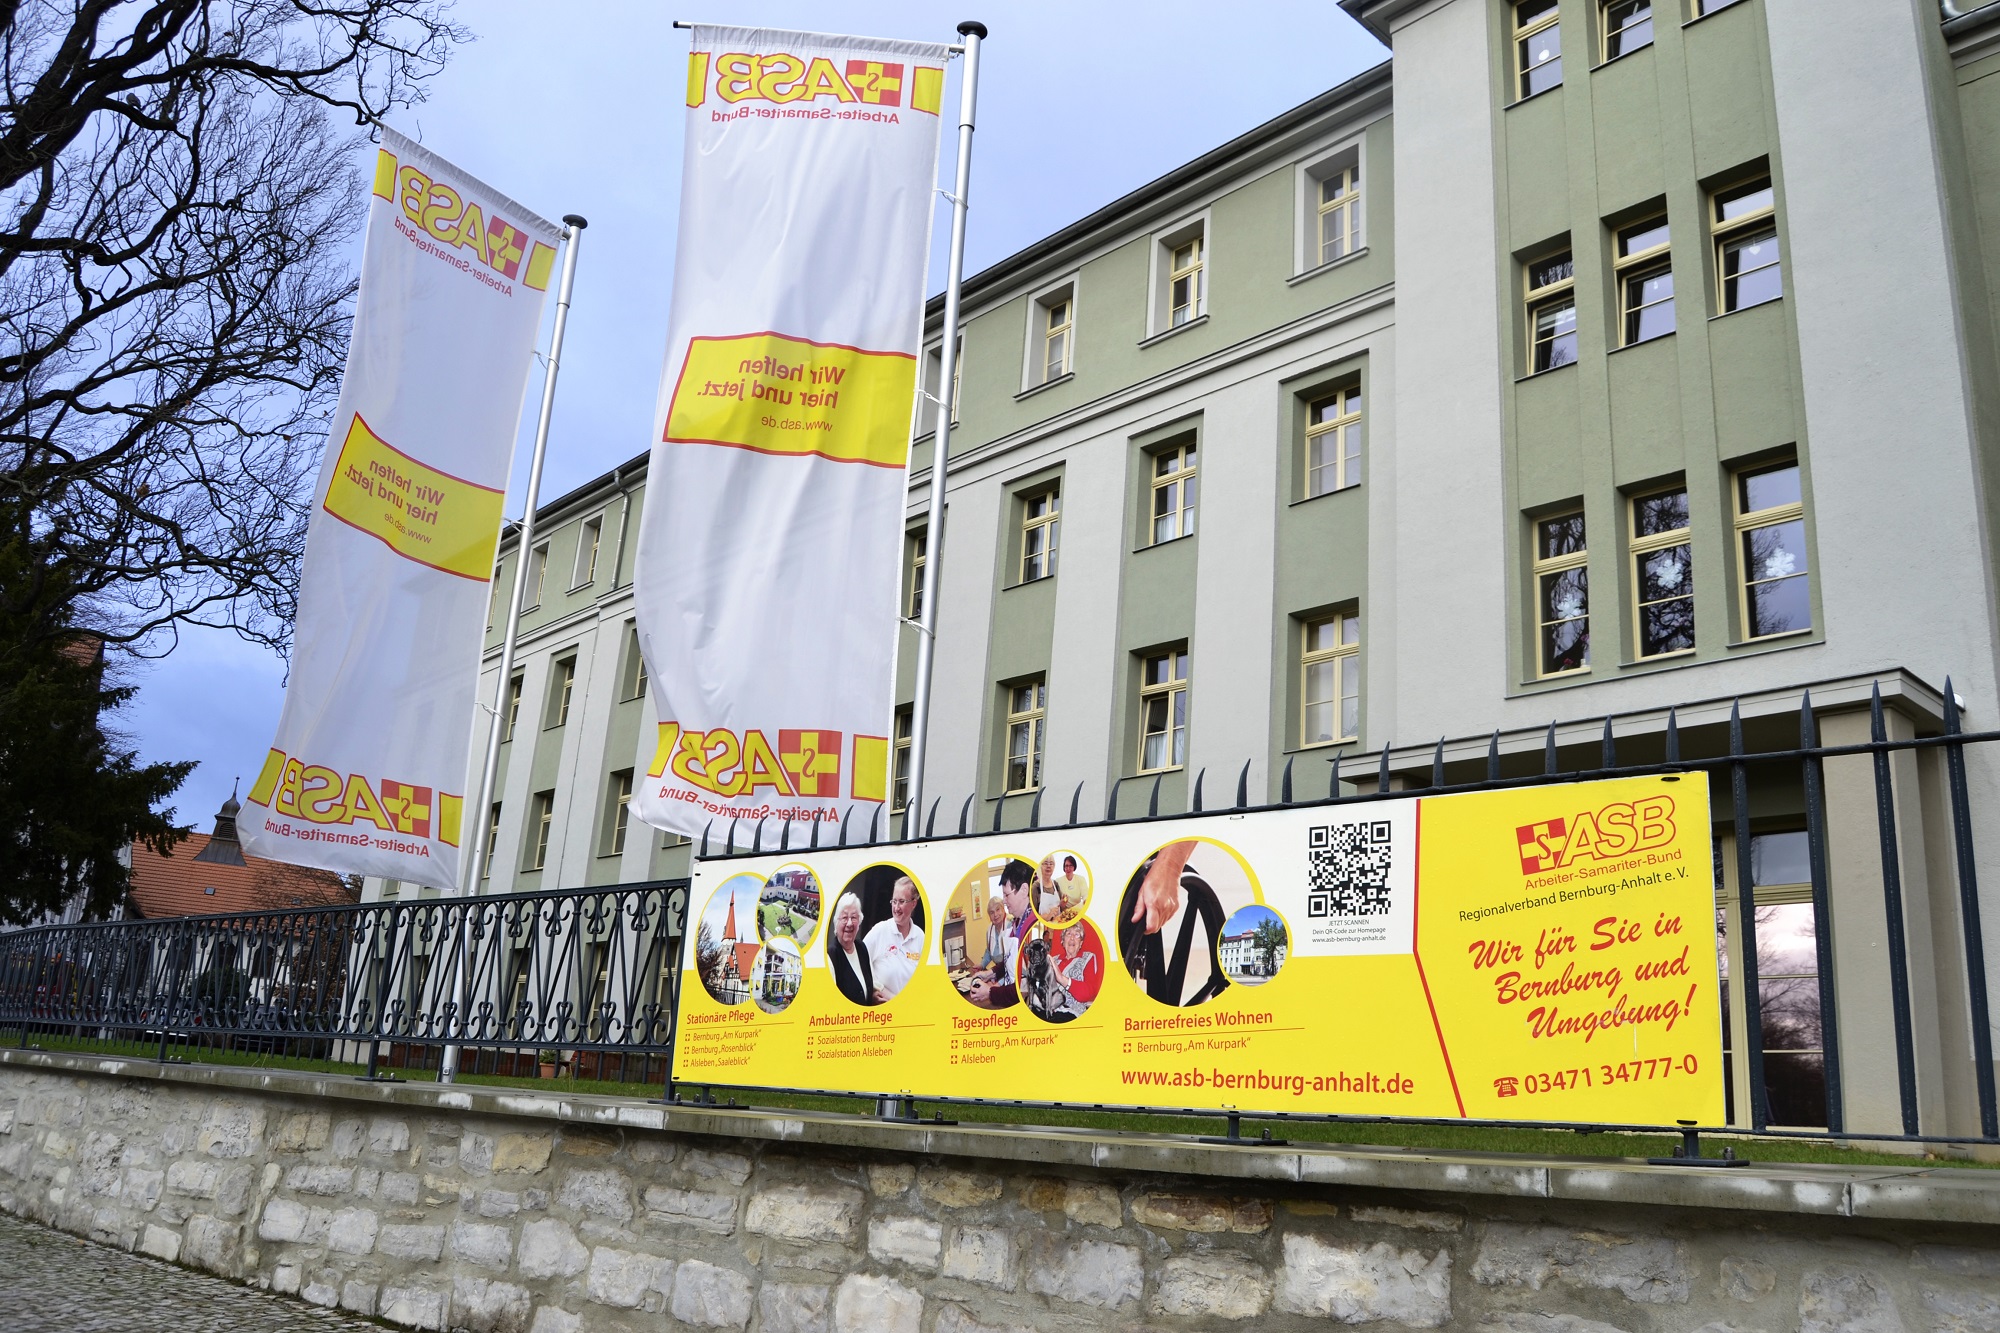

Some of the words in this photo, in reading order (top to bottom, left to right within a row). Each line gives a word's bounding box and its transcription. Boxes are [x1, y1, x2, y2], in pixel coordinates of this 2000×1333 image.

[1556, 795, 1677, 868] ASB
[1525, 848, 1683, 890] Arbeiter-Samariter-Bund
[1459, 892, 1556, 922] Regionalverband
[1559, 870, 1662, 903] Bernburg-Anhalt
[1468, 940, 1524, 970] Wir
[1535, 926, 1577, 970] für
[1590, 916, 1642, 951] Sie
[1654, 912, 1683, 938] in
[1494, 962, 1623, 1005] Bernburg
[1635, 945, 1690, 981] und
[687, 1011, 727, 1024] Stationäre
[728, 1010, 755, 1023] Pflege
[809, 1013, 860, 1026] Ambulante
[862, 1010, 893, 1025] Pflege
[952, 1013, 1018, 1031] Tagespflege
[1124, 1014, 1212, 1031] Barrierefreies
[1215, 1010, 1273, 1026] Wohnen
[1526, 983, 1698, 1043] Umgebung!
[693, 1032, 720, 1042] Bernburg
[817, 1034, 860, 1045] Sozialstation
[862, 1032, 895, 1043] Bernburg
[962, 1038, 1000, 1049] Bernburg
[817, 1048, 860, 1059] Sozialstation
[862, 1047, 893, 1057] Alsleben
[1137, 1041, 1182, 1053] Bernburg
[690, 1058, 714, 1067] Alsleben
[961, 1053, 996, 1064] Alsleben
[1121, 1068, 1415, 1096] www.asb-bernburg-anhalt.de
[1524, 1067, 1592, 1094] 03471
[1601, 1053, 1698, 1085] 34777-0
